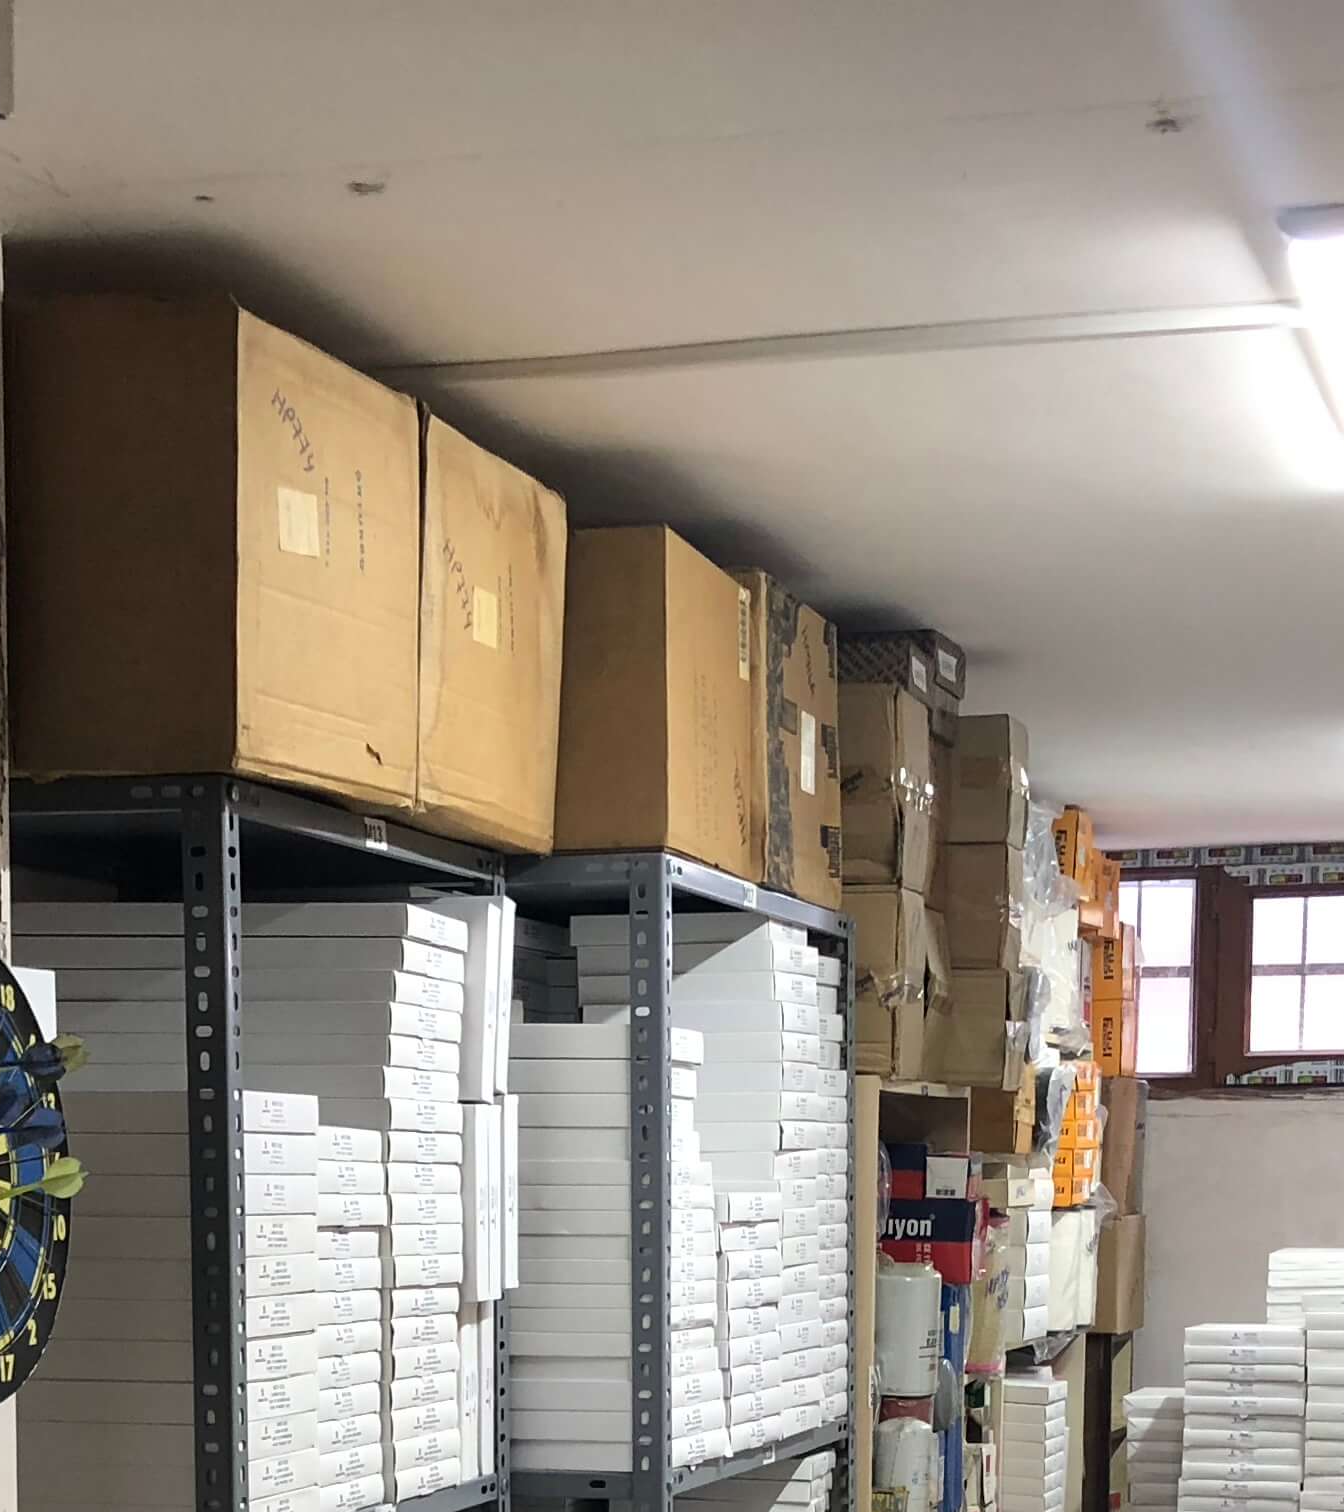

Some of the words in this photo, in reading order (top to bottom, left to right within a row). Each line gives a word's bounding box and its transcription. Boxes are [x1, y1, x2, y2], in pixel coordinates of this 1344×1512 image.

[0, 983, 16, 1013] 18
[52, 1214, 66, 1241] 10
[43, 1271, 57, 1300] 15
[27, 1318, 38, 1346] 2
[0, 1354, 16, 1382] 17
